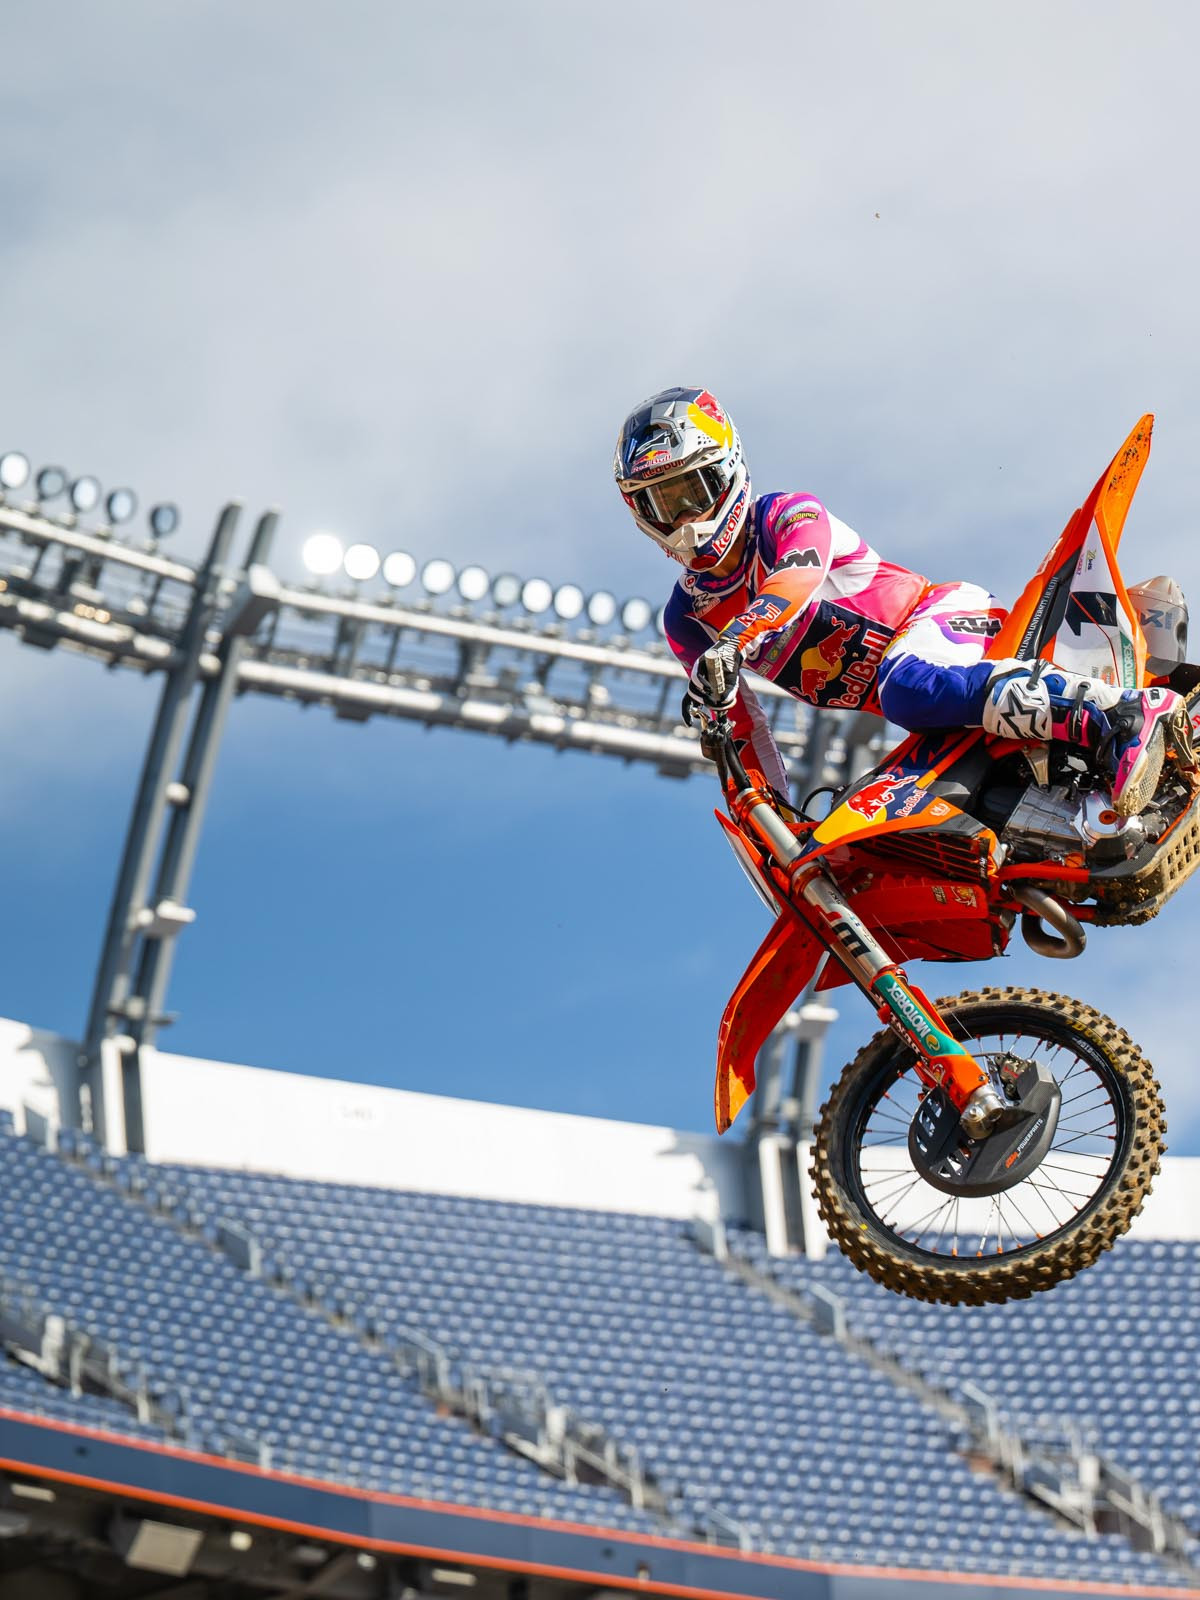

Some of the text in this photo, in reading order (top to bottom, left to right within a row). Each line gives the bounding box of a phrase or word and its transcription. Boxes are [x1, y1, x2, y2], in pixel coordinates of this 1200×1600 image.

[948, 616, 1002, 637] KTM
[1021, 630, 1035, 649] LINDA
[1029, 597, 1048, 632] UNIVERSITY
[886, 981, 932, 1038] MOTOREX
[1017, 1118, 1043, 1153] POWERPARTS
